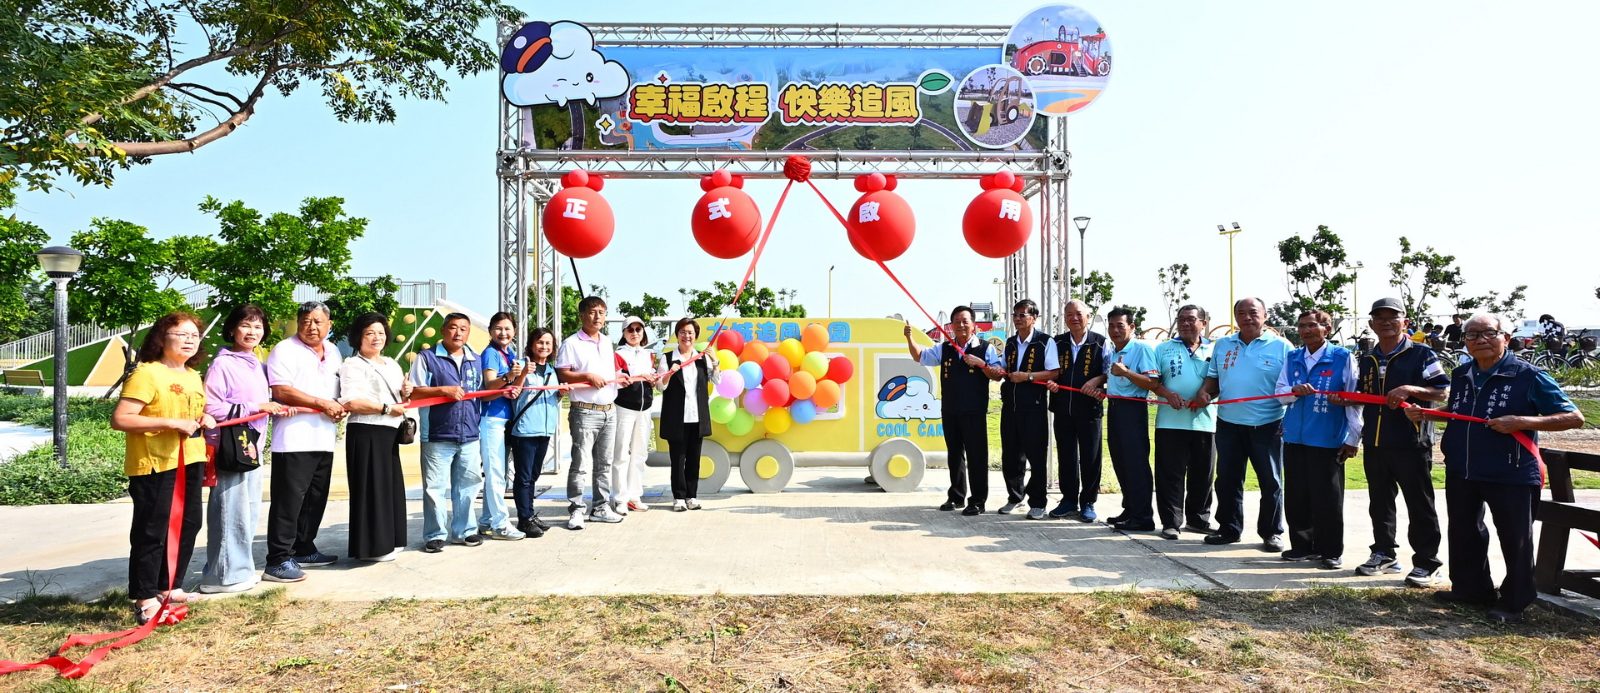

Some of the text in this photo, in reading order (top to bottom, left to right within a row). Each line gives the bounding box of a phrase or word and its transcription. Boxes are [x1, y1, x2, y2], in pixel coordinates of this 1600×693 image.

[632, 83, 920, 121] 幸福啟程 快樂追風
[562, 198, 588, 220] 正
[708, 198, 731, 220] 式
[999, 199, 1022, 221] 用
[706, 321, 851, 343] 大城追風園
[1498, 384, 1513, 408] 彰化縣
[876, 422, 911, 437] COOL
